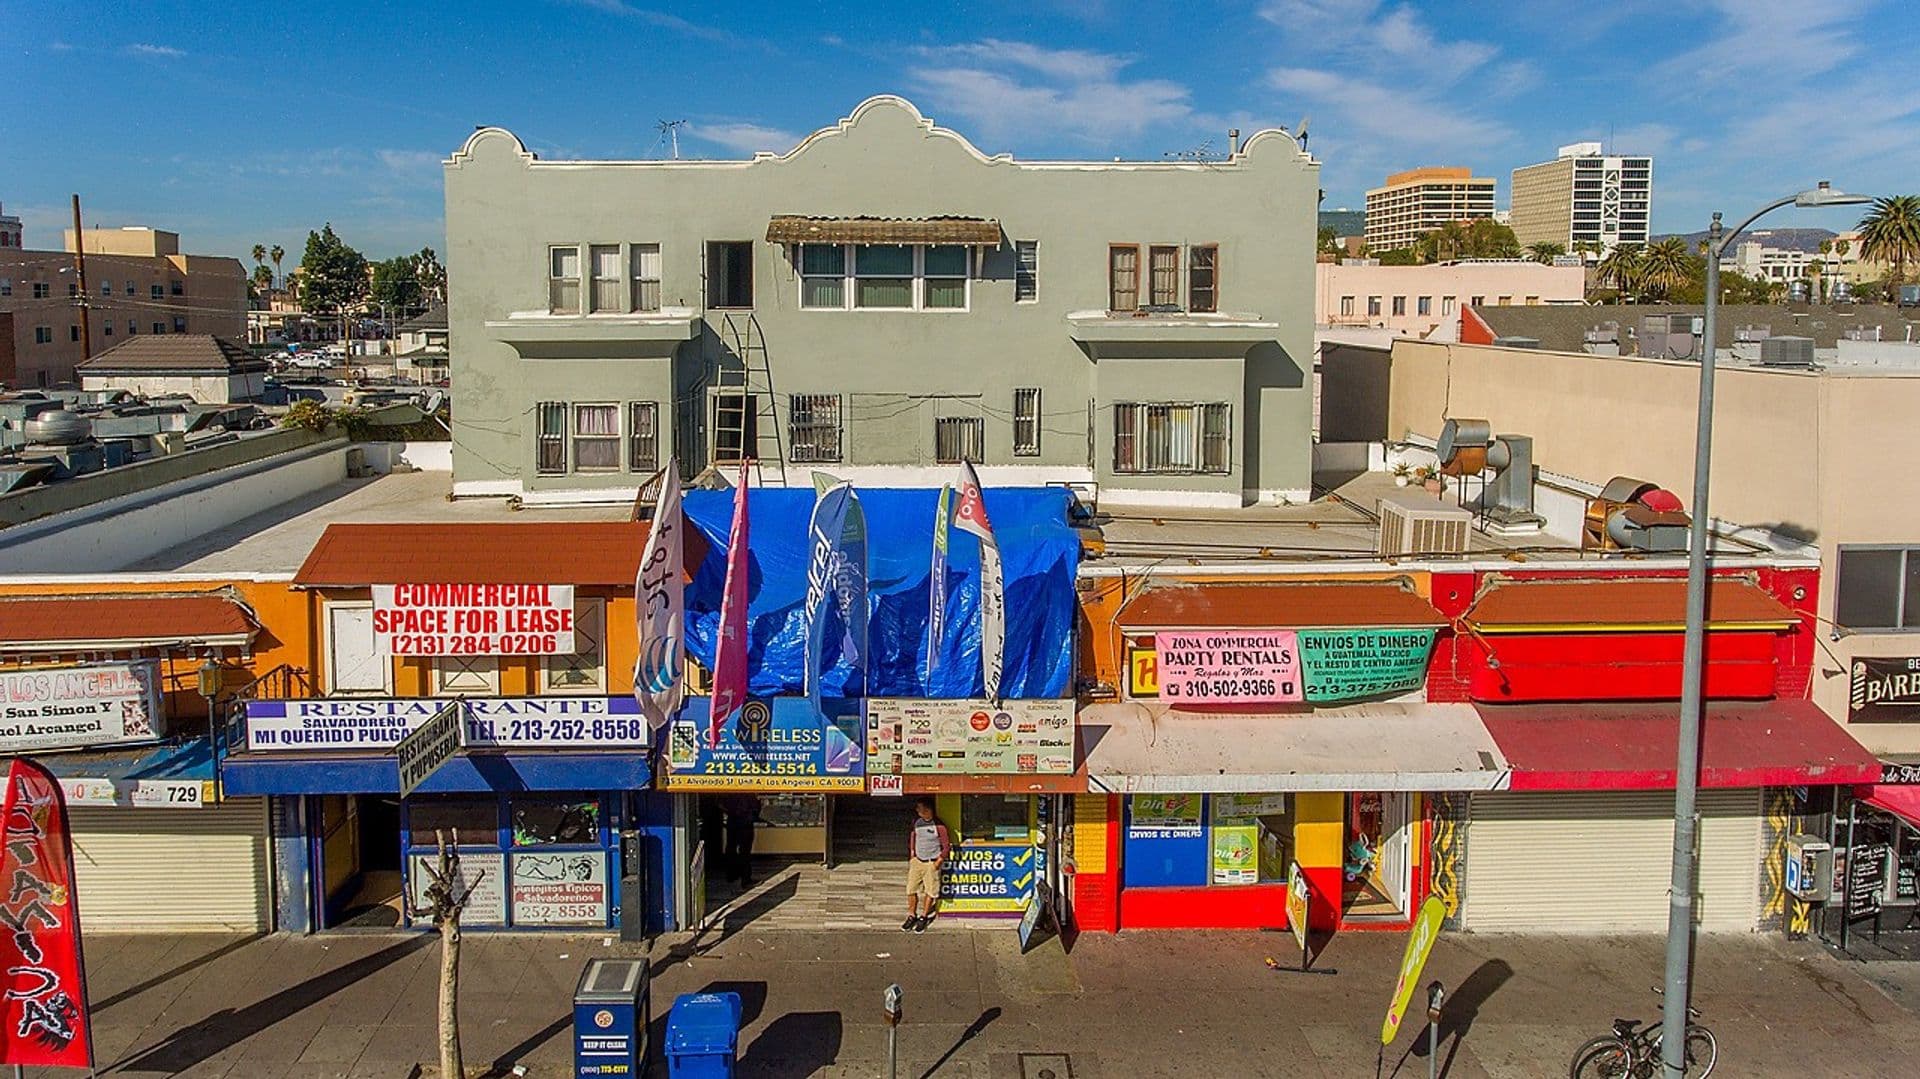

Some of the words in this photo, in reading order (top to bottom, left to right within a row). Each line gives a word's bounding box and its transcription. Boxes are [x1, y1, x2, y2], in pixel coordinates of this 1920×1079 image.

[394, 584, 552, 607] COMMERCIAL
[374, 609, 448, 633] SPACE
[454, 609, 498, 633] FOR
[506, 607, 573, 632] LEASE
[391, 635, 444, 654] (213)
[450, 634, 556, 653] 284-0206
[1172, 637, 1201, 649] ZONA
[1206, 637, 1281, 649] COMMERCIAL
[1305, 636, 1354, 649] ENVIOS
[1358, 636, 1375, 648] DE
[1379, 635, 1428, 648] DINERO
[1165, 651, 1215, 665] PARTY
[1222, 650, 1292, 665] RENTALS
[1352, 660, 1362, 668] DE
[1363, 660, 1392, 668] CENTRO
[1194, 668, 1230, 679] Regalos
[9, 674, 49, 703] LOS
[54, 670, 149, 701] ANGELES
[1307, 678, 1419, 695] 213-375-7080
[6, 708, 38, 719] San
[42, 704, 97, 717] Simon
[101, 701, 113, 713] Y
[25, 720, 102, 735] Arcangel
[302, 716, 407, 728] SALVADOREÑO
[255, 731, 276, 744] MI
[280, 729, 353, 744] QUERIDO
[511, 719, 641, 741] 213-252-8558
[705, 761, 818, 775] 213.283.5514
[781, 778, 815, 787] Angeles
[872, 777, 901, 789] RENT
[167, 787, 197, 802] 729
[942, 861, 1005, 870] DINERO
[942, 874, 993, 884] CAMBIO
[942, 885, 1008, 894] CHEQUES
[521, 905, 597, 918] 252-8558
[583, 1041, 599, 1049] KEEP
